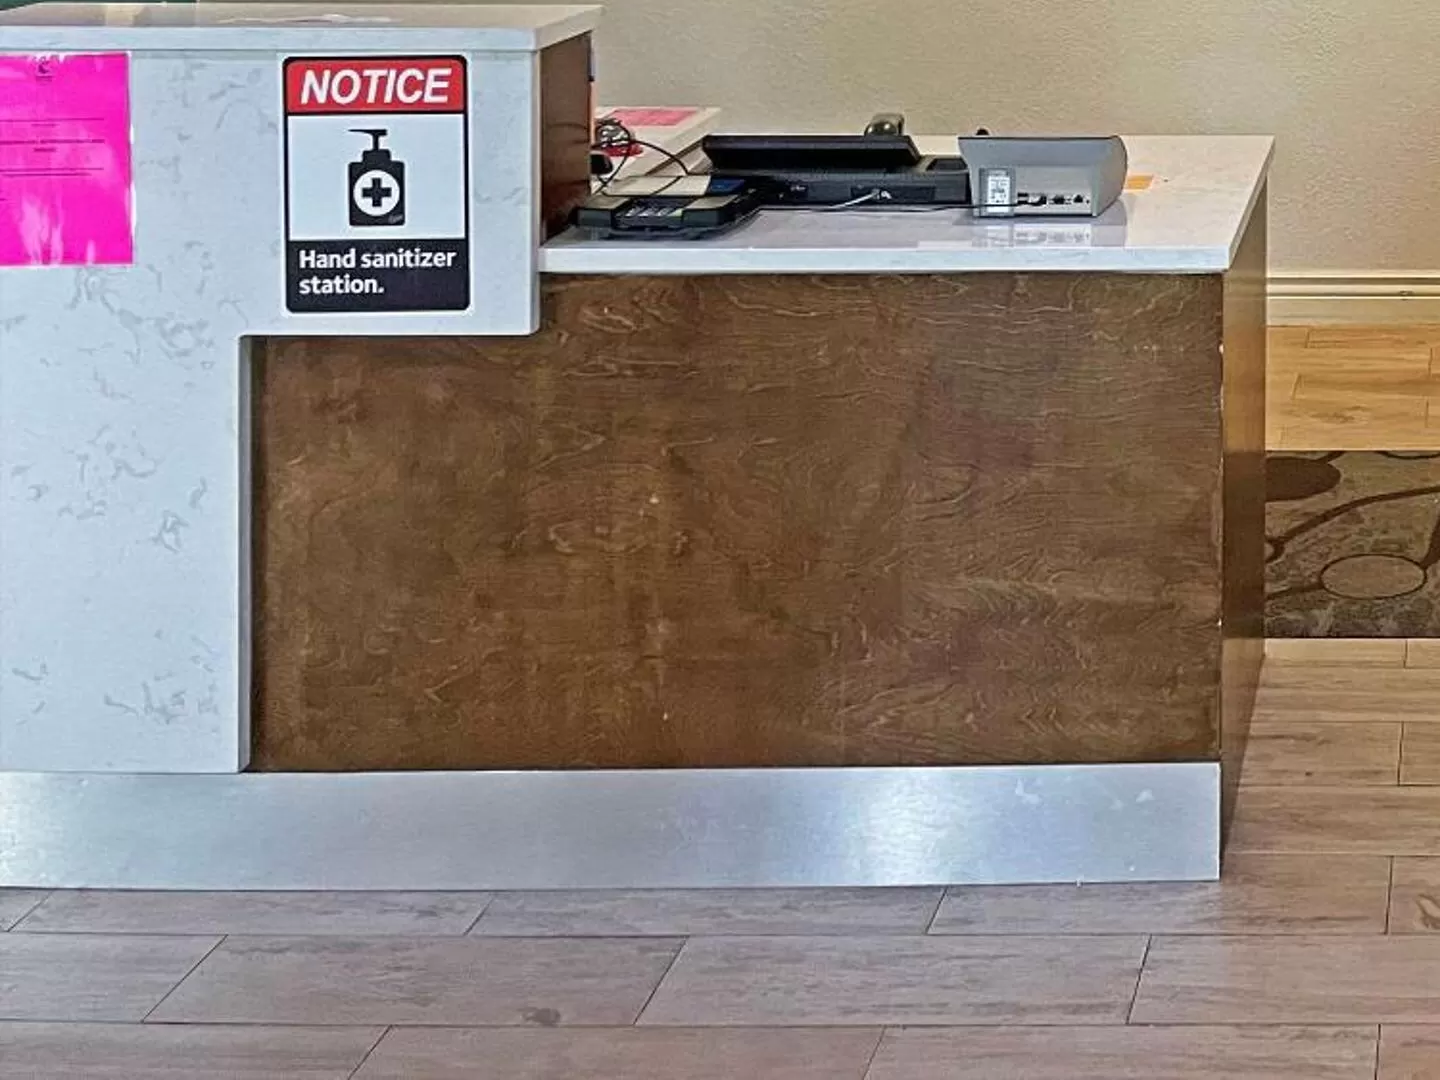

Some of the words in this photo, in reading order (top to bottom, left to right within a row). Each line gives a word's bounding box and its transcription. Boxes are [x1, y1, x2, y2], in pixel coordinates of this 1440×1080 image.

[300, 68, 452, 105] NOTICE
[299, 248, 356, 269] Hand
[360, 248, 457, 269] sanitizer
[299, 274, 385, 295] station.
